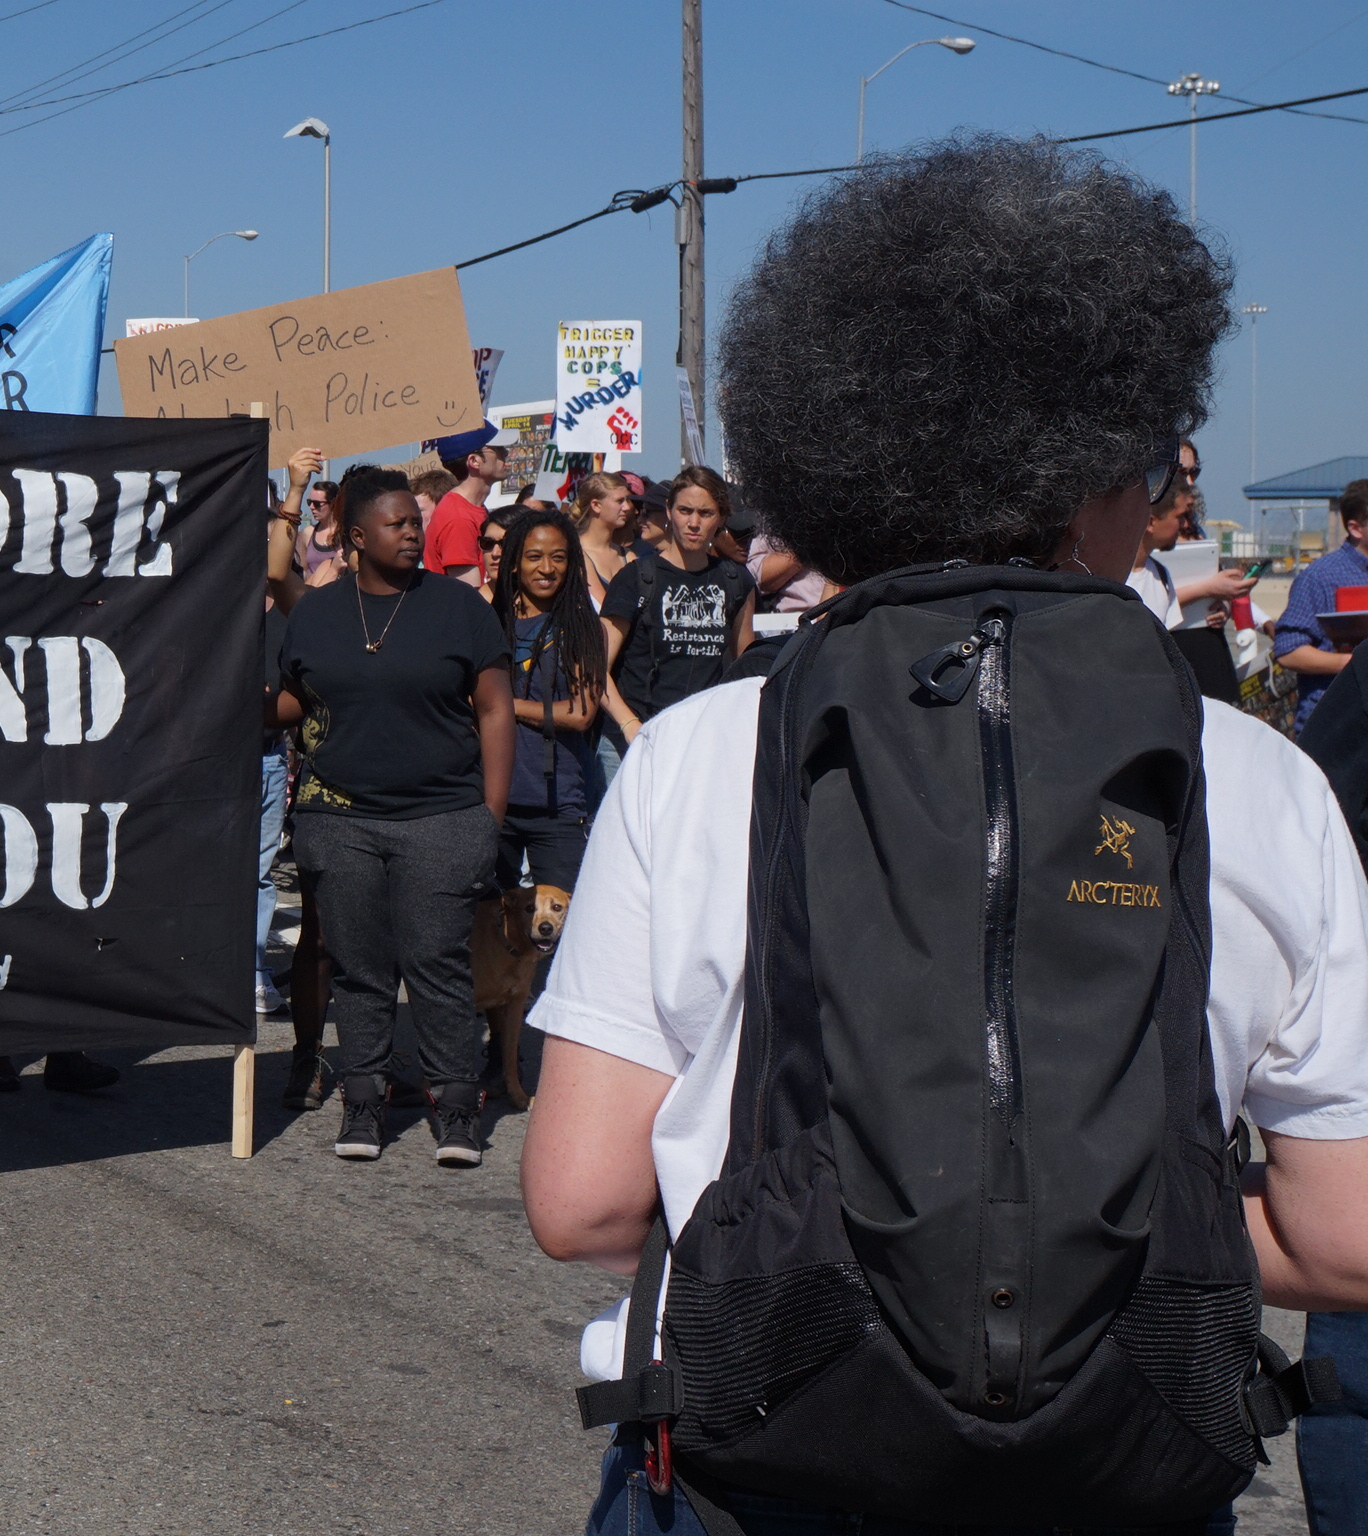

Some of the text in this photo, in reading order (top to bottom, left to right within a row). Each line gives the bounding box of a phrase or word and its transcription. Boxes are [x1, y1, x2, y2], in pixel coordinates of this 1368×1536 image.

[559, 325, 635, 342] TRIGGER
[564, 345, 623, 359] HAPPY
[148, 346, 248, 392] Make
[567, 360, 623, 375] COPS
[324, 371, 420, 423] Police
[557, 370, 639, 431] MURDER
[662, 628, 725, 643] Resistance
[670, 644, 682, 653] is
